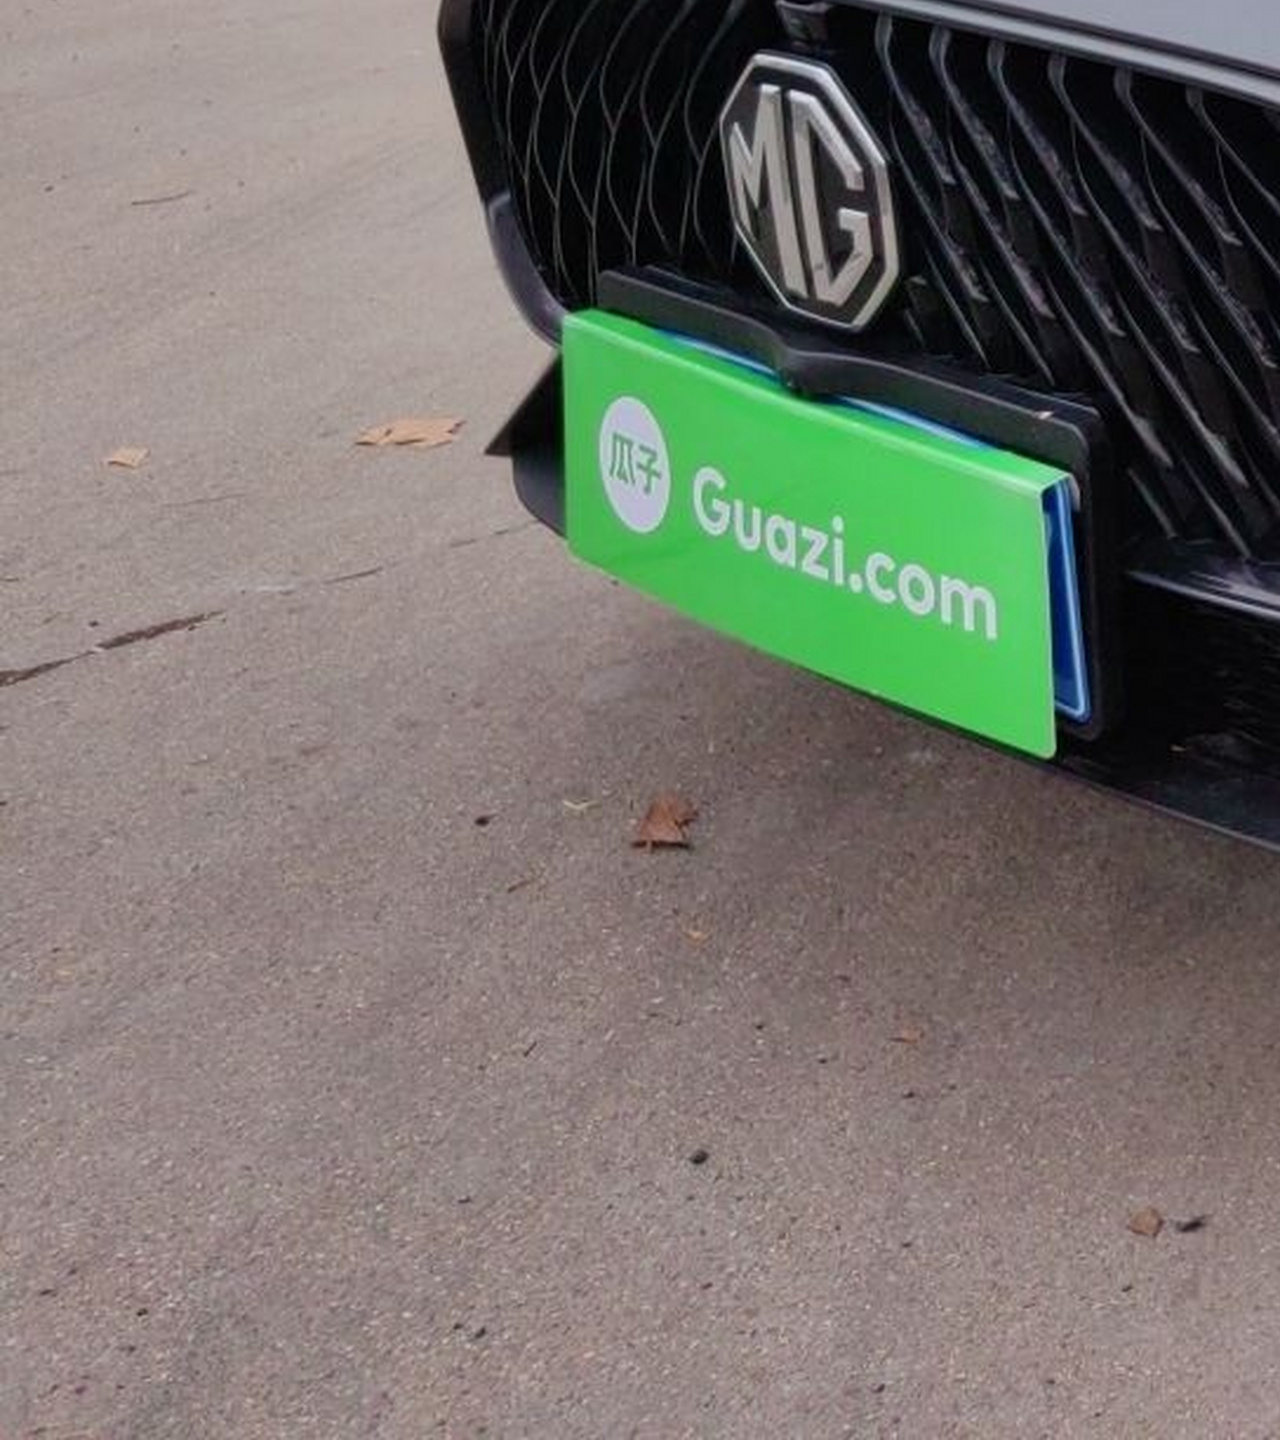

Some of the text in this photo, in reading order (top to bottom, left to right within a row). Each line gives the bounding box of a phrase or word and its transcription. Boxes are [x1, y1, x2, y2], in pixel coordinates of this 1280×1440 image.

[729, 83, 874, 307] MG
[609, 431, 662, 495] 瓜子
[692, 466, 998, 640] Guazi.com
